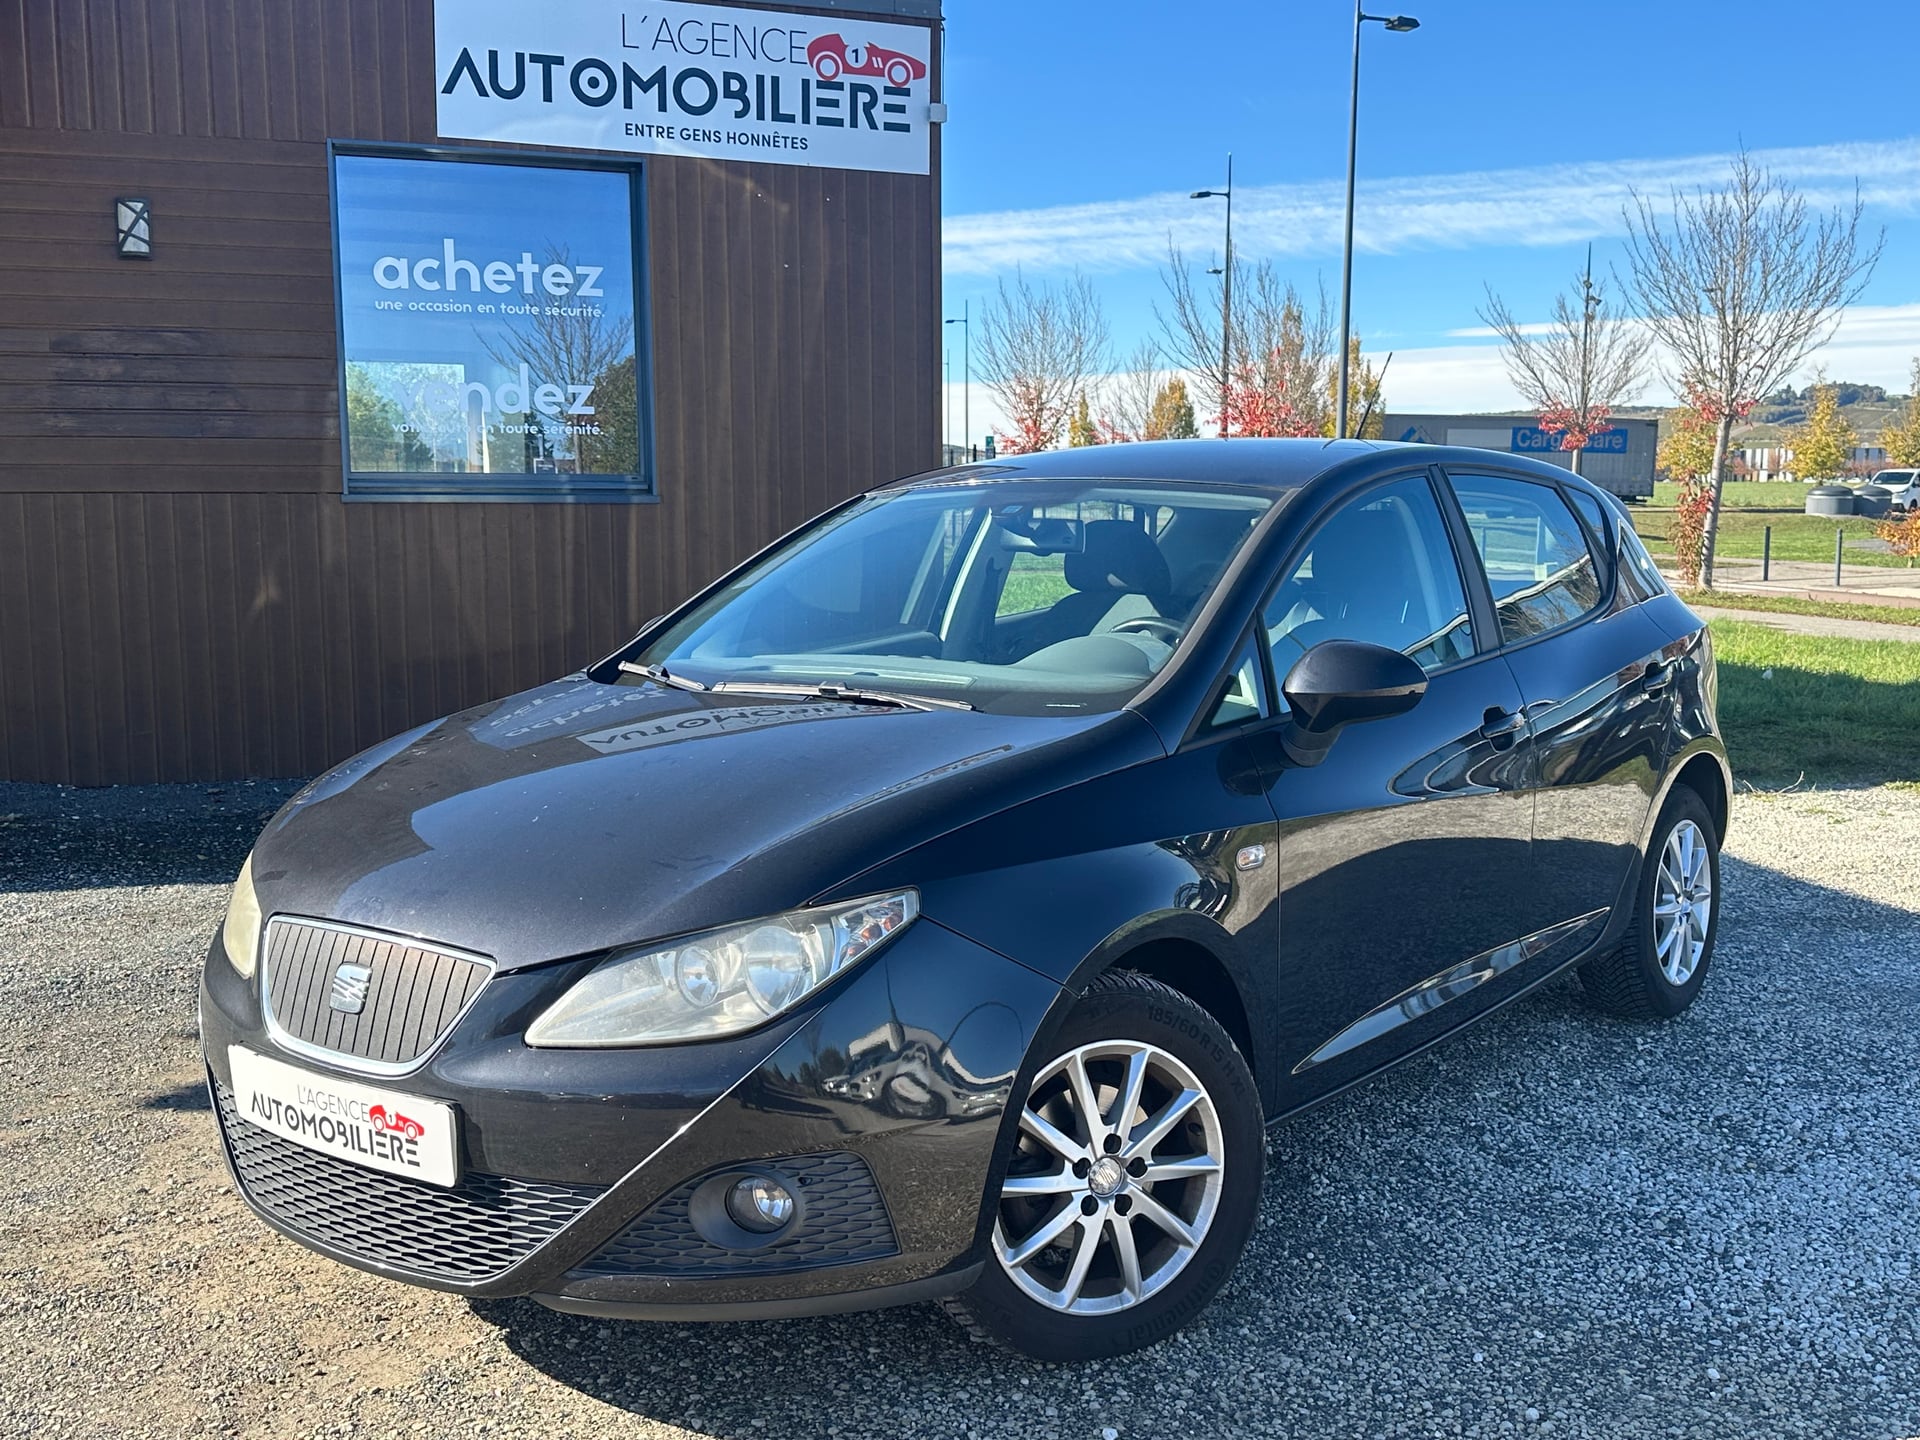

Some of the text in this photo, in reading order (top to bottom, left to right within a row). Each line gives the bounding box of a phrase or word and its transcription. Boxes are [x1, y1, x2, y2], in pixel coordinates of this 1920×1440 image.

[620, 13, 808, 65] L'AGENCE
[624, 122, 809, 151] ENTRE GENS HONNÊTES
[372, 238, 604, 297] achetez
[374, 298, 606, 318] une occasion en toute sécurité.
[393, 363, 596, 415] vendez
[500, 422, 539, 434] toute
[543, 421, 605, 435] sérénité.
[1516, 428, 1623, 451] Carg are
[1148, 1005, 1200, 1040] 185/60
[296, 1083, 371, 1123] L'AGENCE
